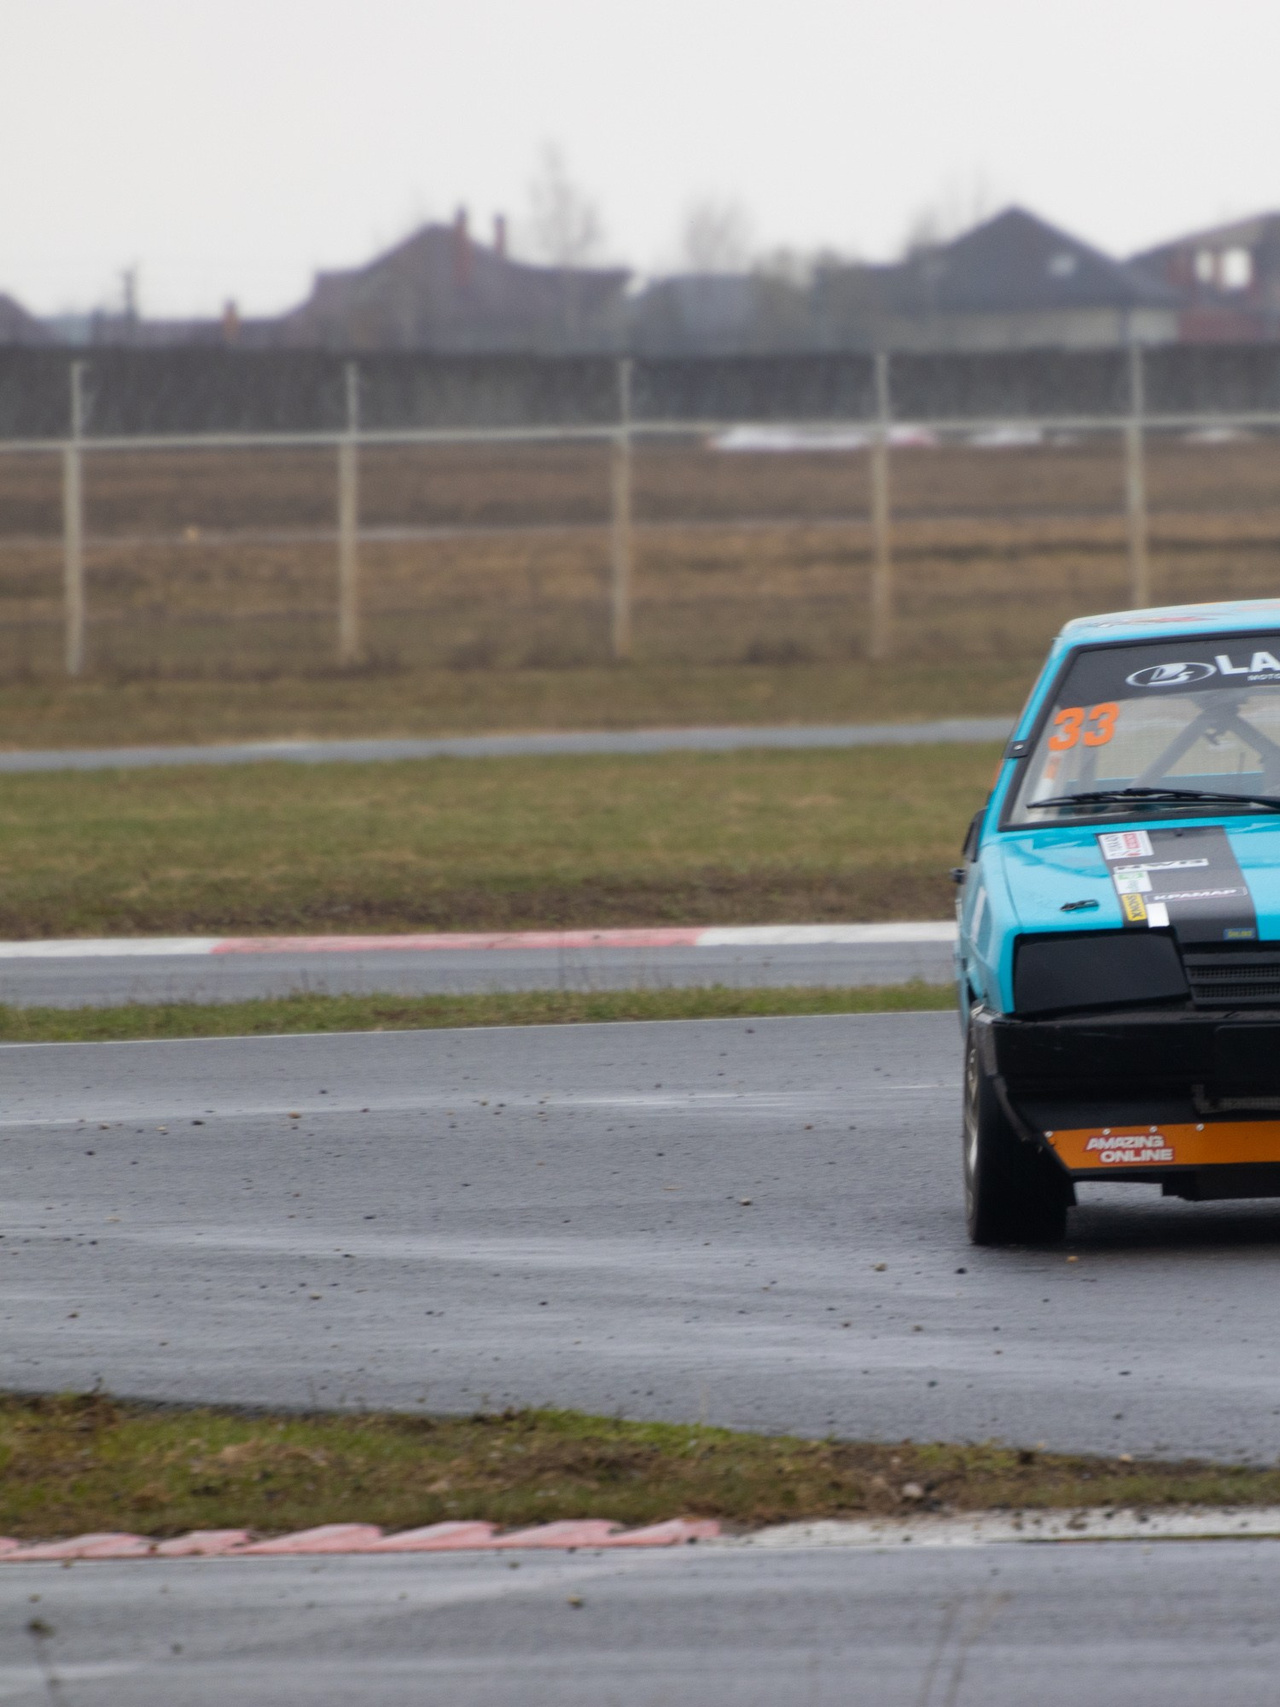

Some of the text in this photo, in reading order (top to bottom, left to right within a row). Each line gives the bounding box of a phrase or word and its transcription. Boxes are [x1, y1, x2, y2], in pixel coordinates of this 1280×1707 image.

[1048, 701, 1120, 751] 33
[1086, 1135, 1164, 1150] AMAZING
[1100, 1148, 1174, 1162] ONLINE
